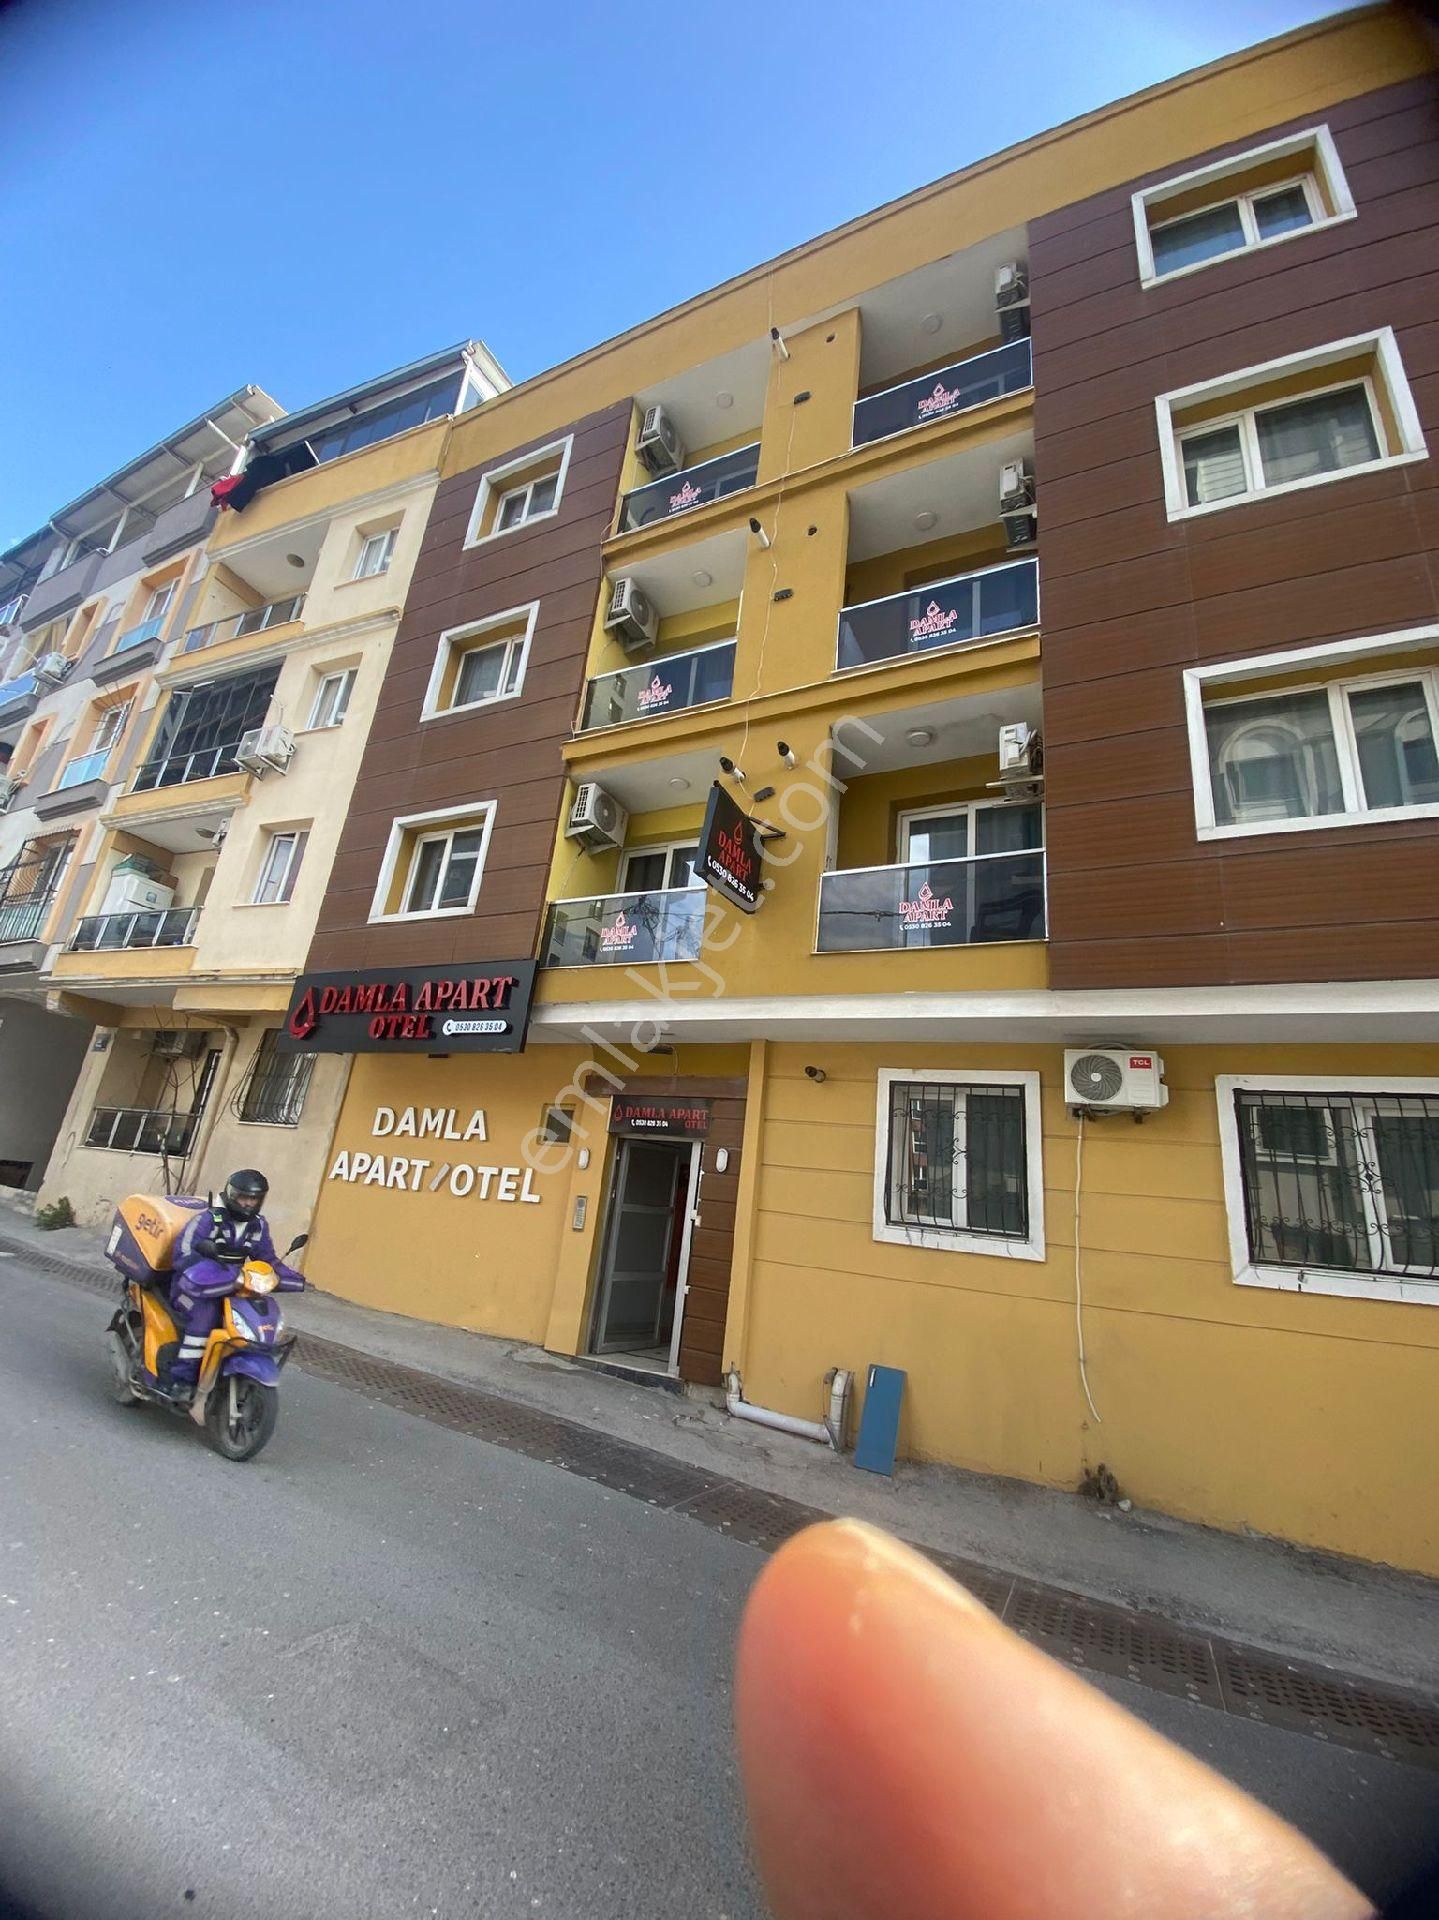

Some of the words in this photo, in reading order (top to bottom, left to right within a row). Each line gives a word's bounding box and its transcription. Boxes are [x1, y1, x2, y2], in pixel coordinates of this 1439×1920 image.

[910, 609, 958, 630] DAMLA
[913, 620, 954, 637] APART
[718, 830, 752, 874] DAMLA
[719, 849, 748, 881] APART
[712, 860, 727, 878] 0530
[738, 883, 747, 895] 35
[746, 890, 755, 902] 04
[899, 897, 954, 913] DAMLA
[902, 908, 948, 922] APART
[600, 924, 638, 937] DAMLA
[318, 982, 407, 1014] DAMLA
[413, 976, 513, 1011] APART
[368, 1013, 431, 1040] OTEL
[455, 1023, 472, 1031] 0530
[484, 1022, 494, 1031] 35
[371, 1106, 488, 1141] DAMLA
[626, 1106, 665, 1119] DAMLA
[669, 1108, 709, 1120] APART
[684, 1120, 708, 1130] OTEL
[135, 1213, 165, 1239] getir
